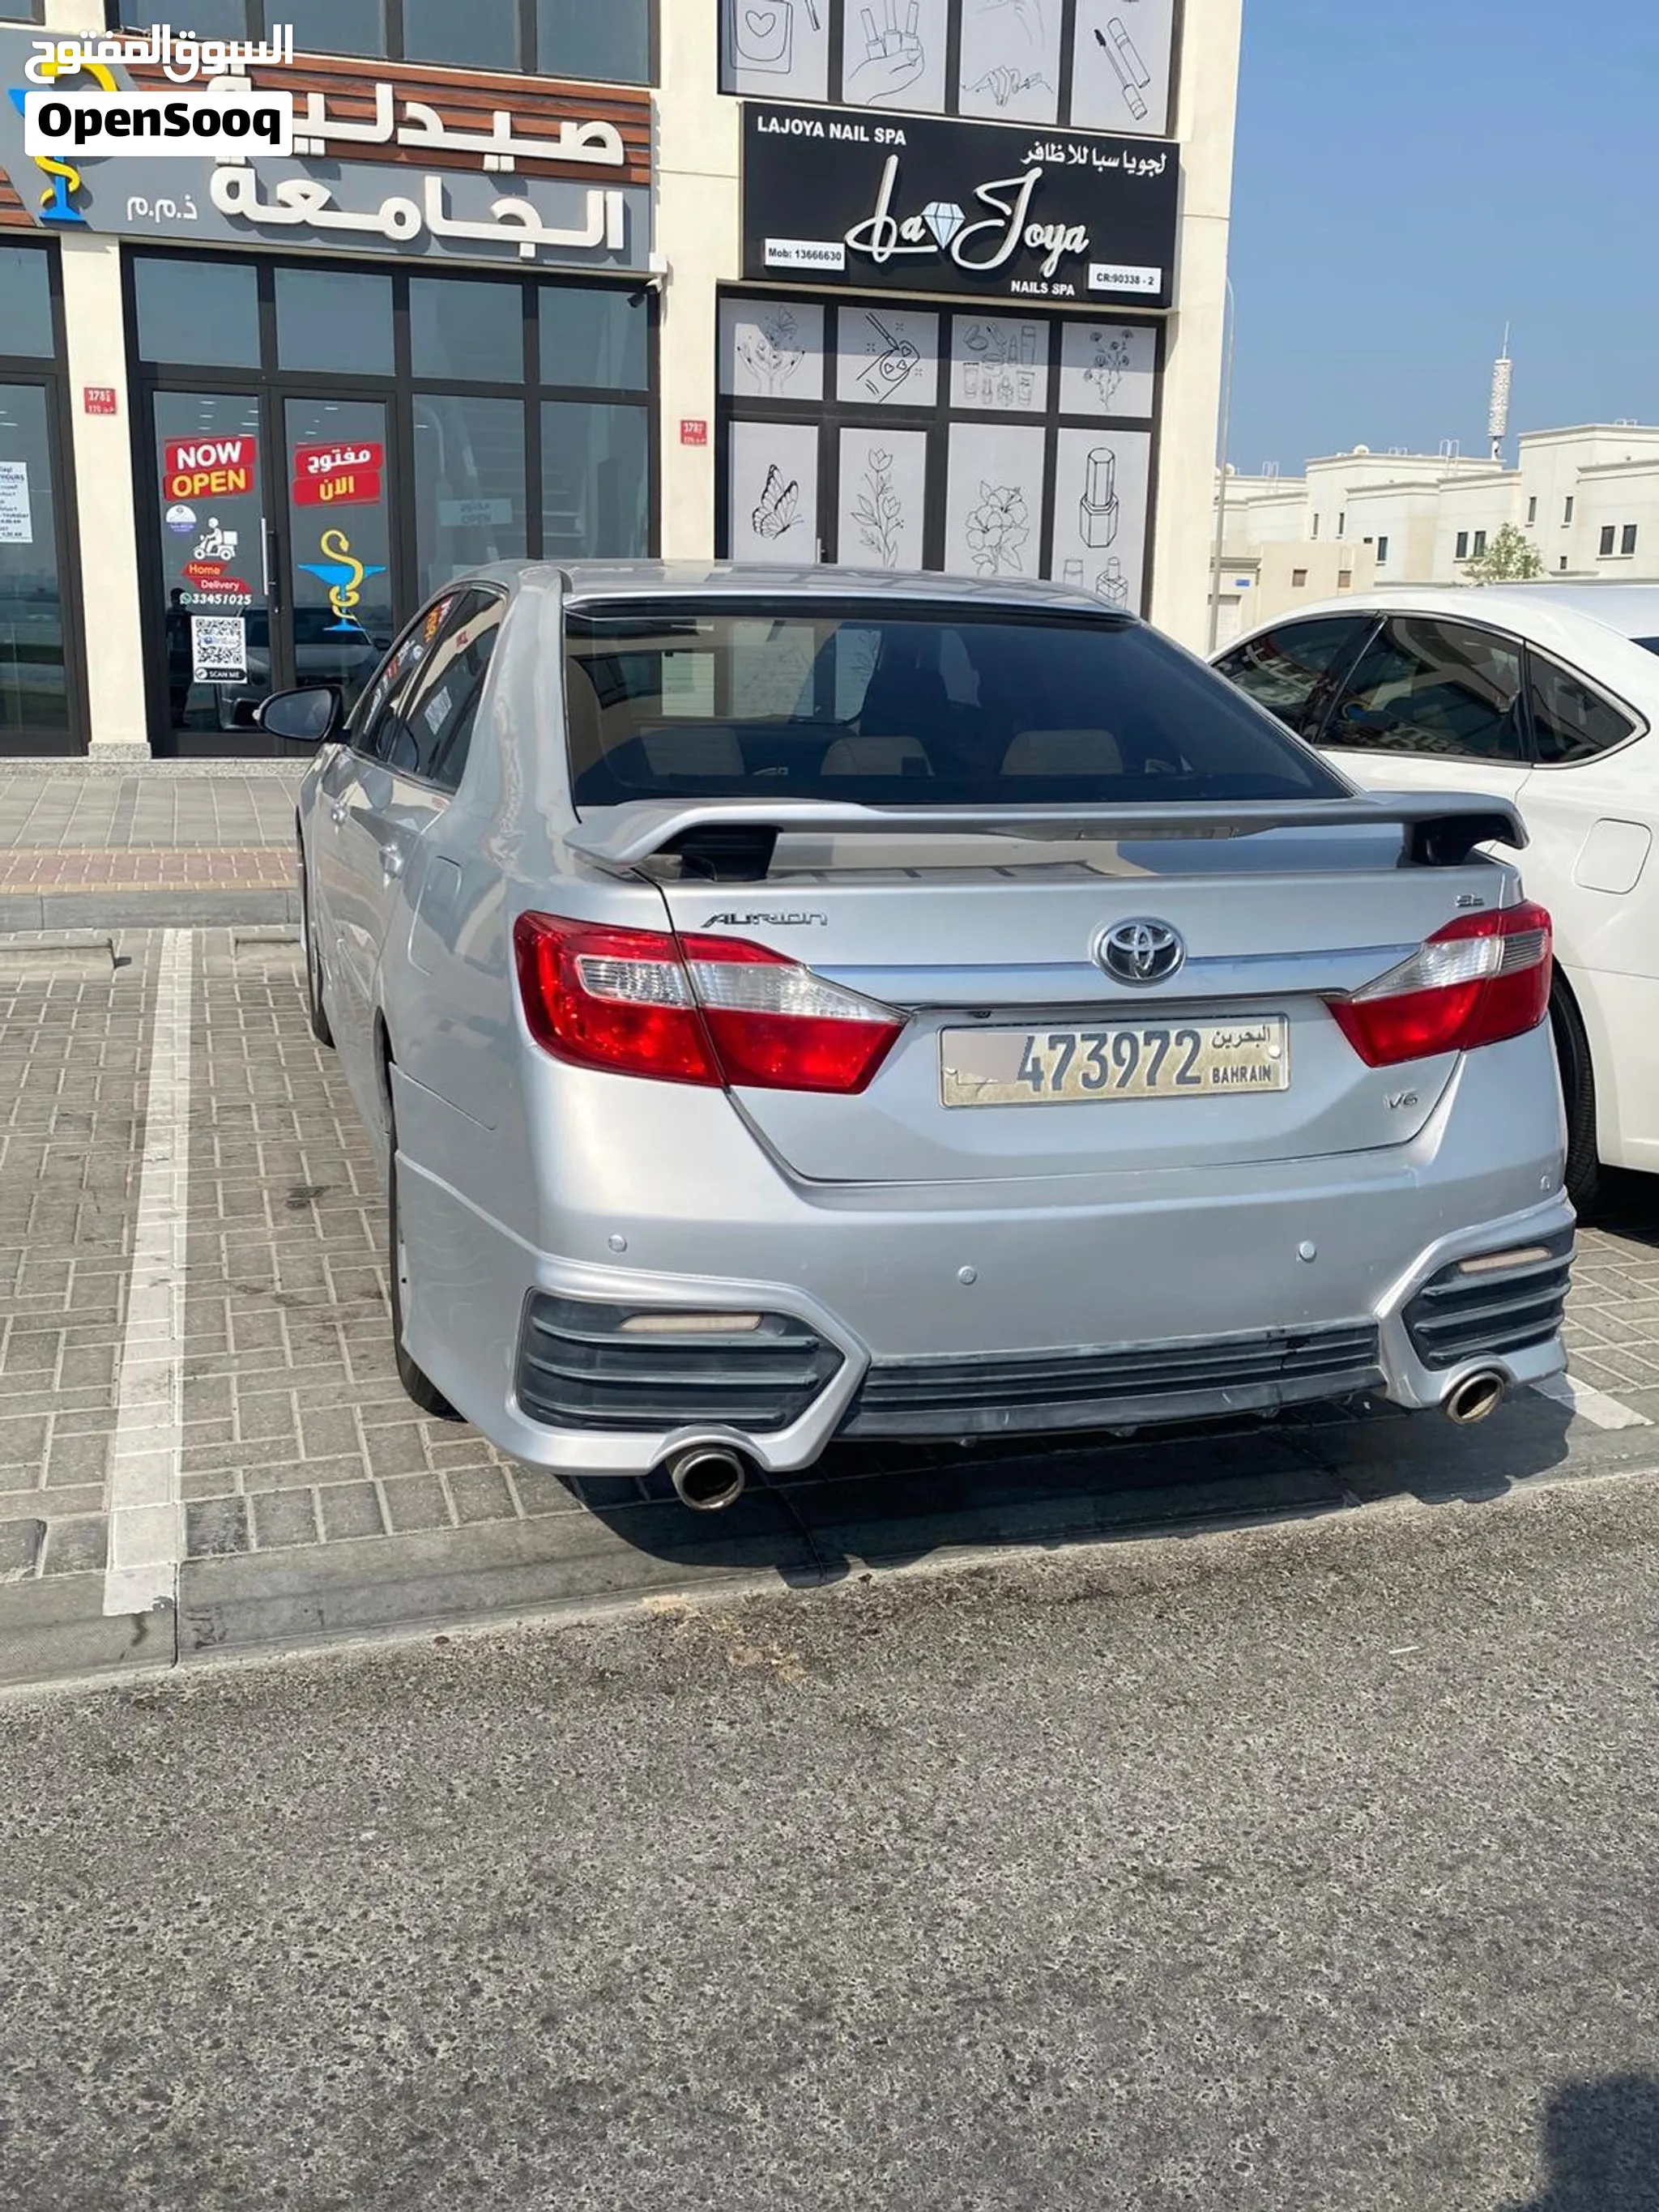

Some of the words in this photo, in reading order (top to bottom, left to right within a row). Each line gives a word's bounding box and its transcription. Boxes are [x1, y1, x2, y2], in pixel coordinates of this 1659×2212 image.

[757, 116, 825, 138] LAJOYA
[829, 123, 869, 143] NAIL
[873, 127, 906, 145] SPA
[1093, 147, 1120, 172] سبا
[210, 156, 625, 259] الجامعة
[768, 247, 792, 259] Mob:
[1011, 280, 1048, 294] NAILS
[1052, 283, 1076, 296] SPA
[177, 441, 242, 470] NOW
[307, 446, 371, 474] مفتوح
[172, 468, 246, 497] OPEN
[318, 475, 355, 501] الان
[189, 564, 221, 575] Home
[200, 579, 241, 592] Delivery
[192, 593, 252, 605] 33451025
[1212, 1025, 1271, 1049] البحرين
[1017, 1029, 1202, 1092] 473972
[1212, 1065, 1272, 1084] BAHRAIN
